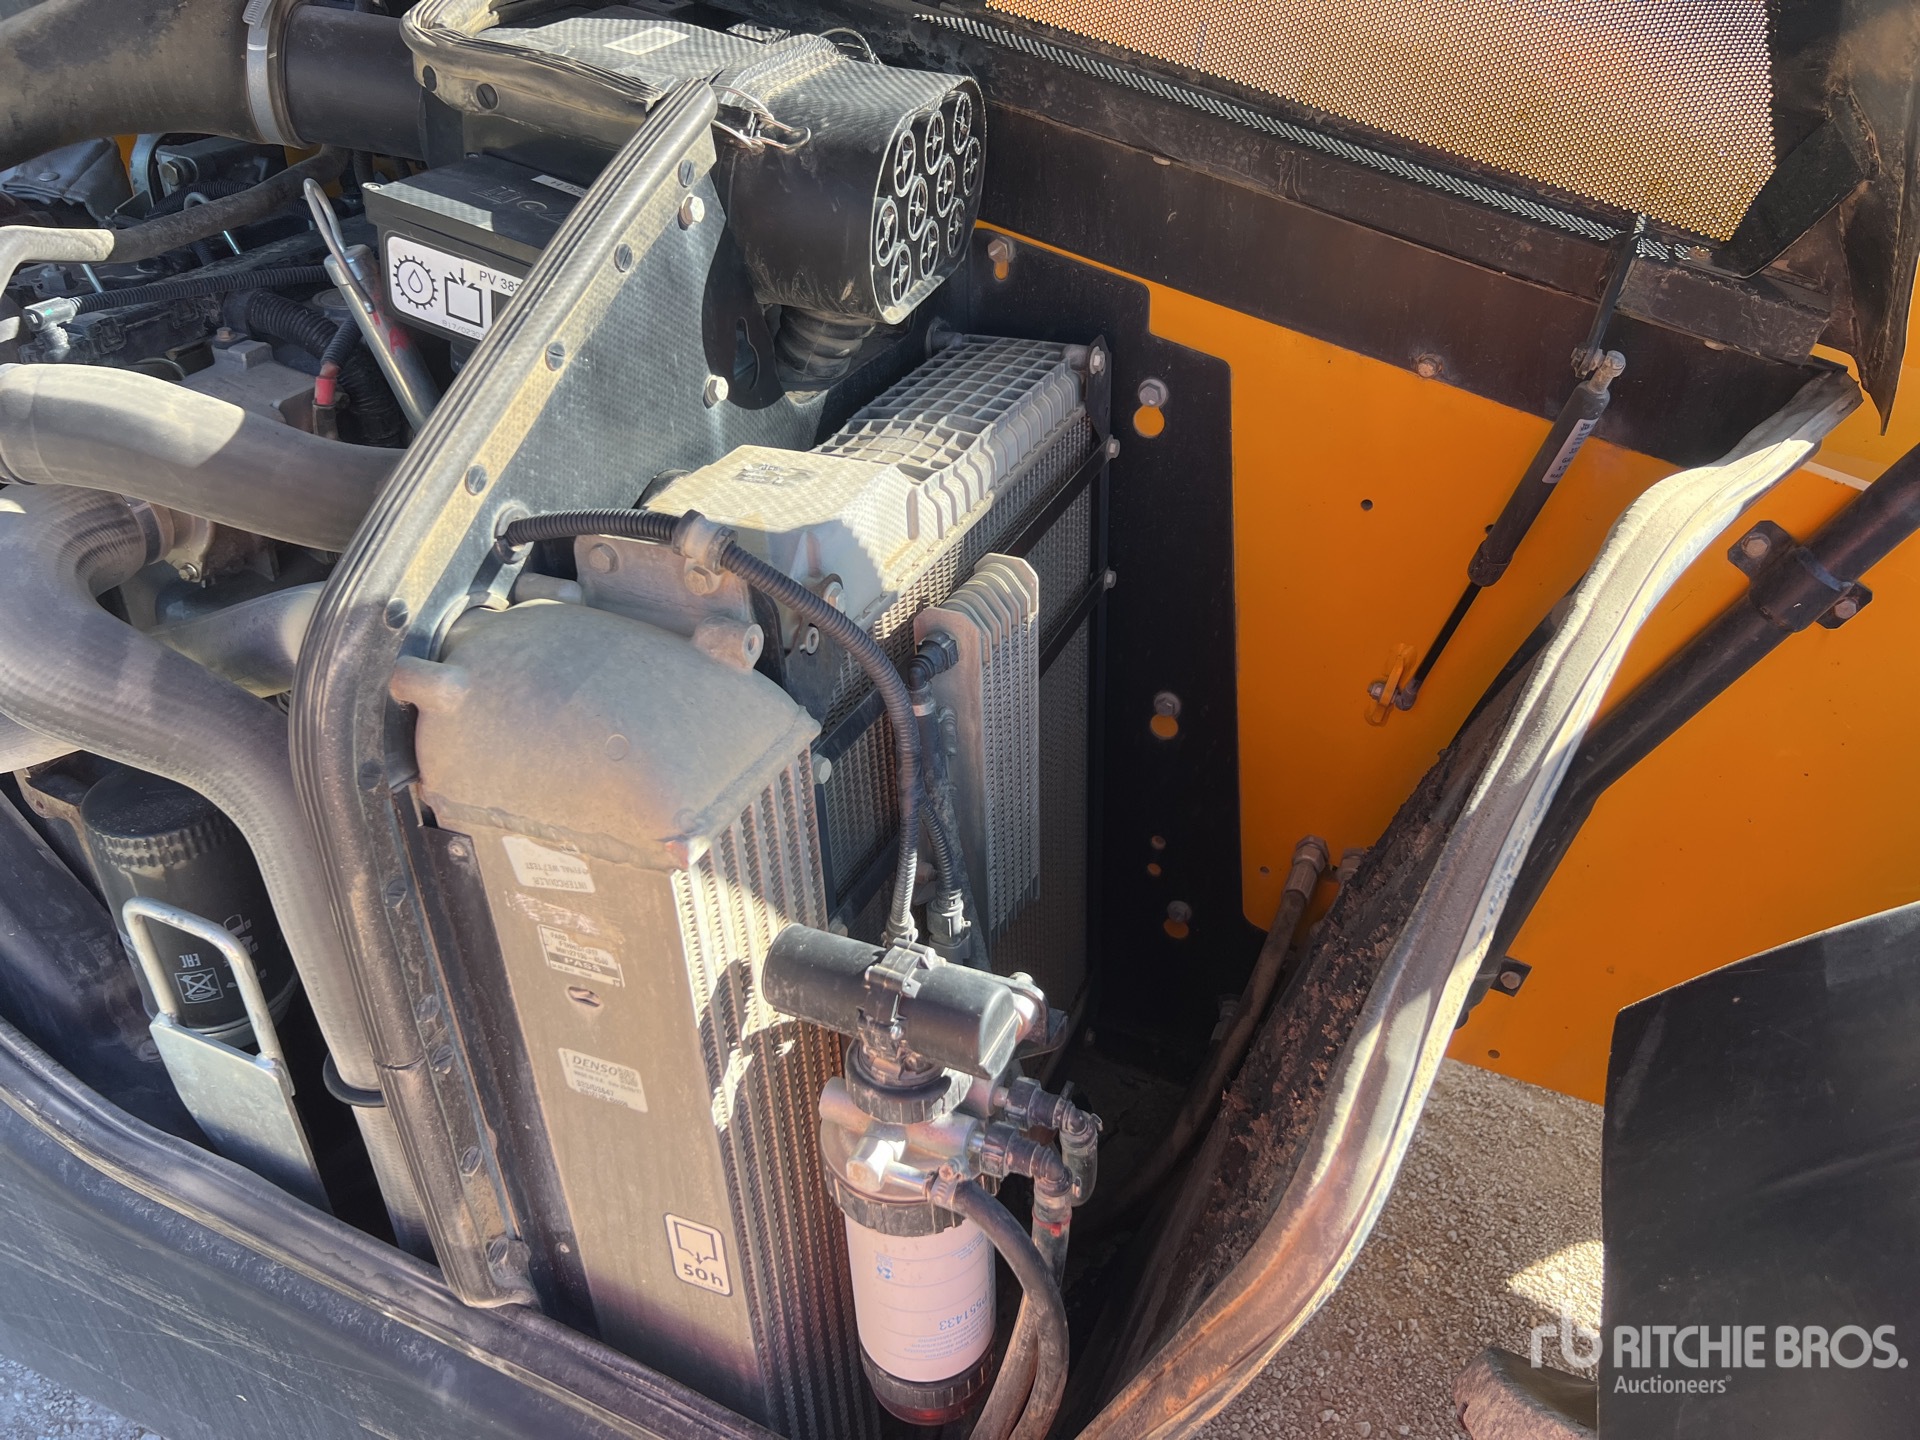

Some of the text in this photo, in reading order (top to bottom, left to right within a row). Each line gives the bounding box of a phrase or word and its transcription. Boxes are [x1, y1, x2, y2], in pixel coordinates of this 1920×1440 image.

[479, 270, 497, 285] PV
[564, 957, 601, 972] PASS
[573, 1055, 618, 1076] DENSO
[683, 1263, 708, 1281] 50
[711, 1272, 723, 1287] h
